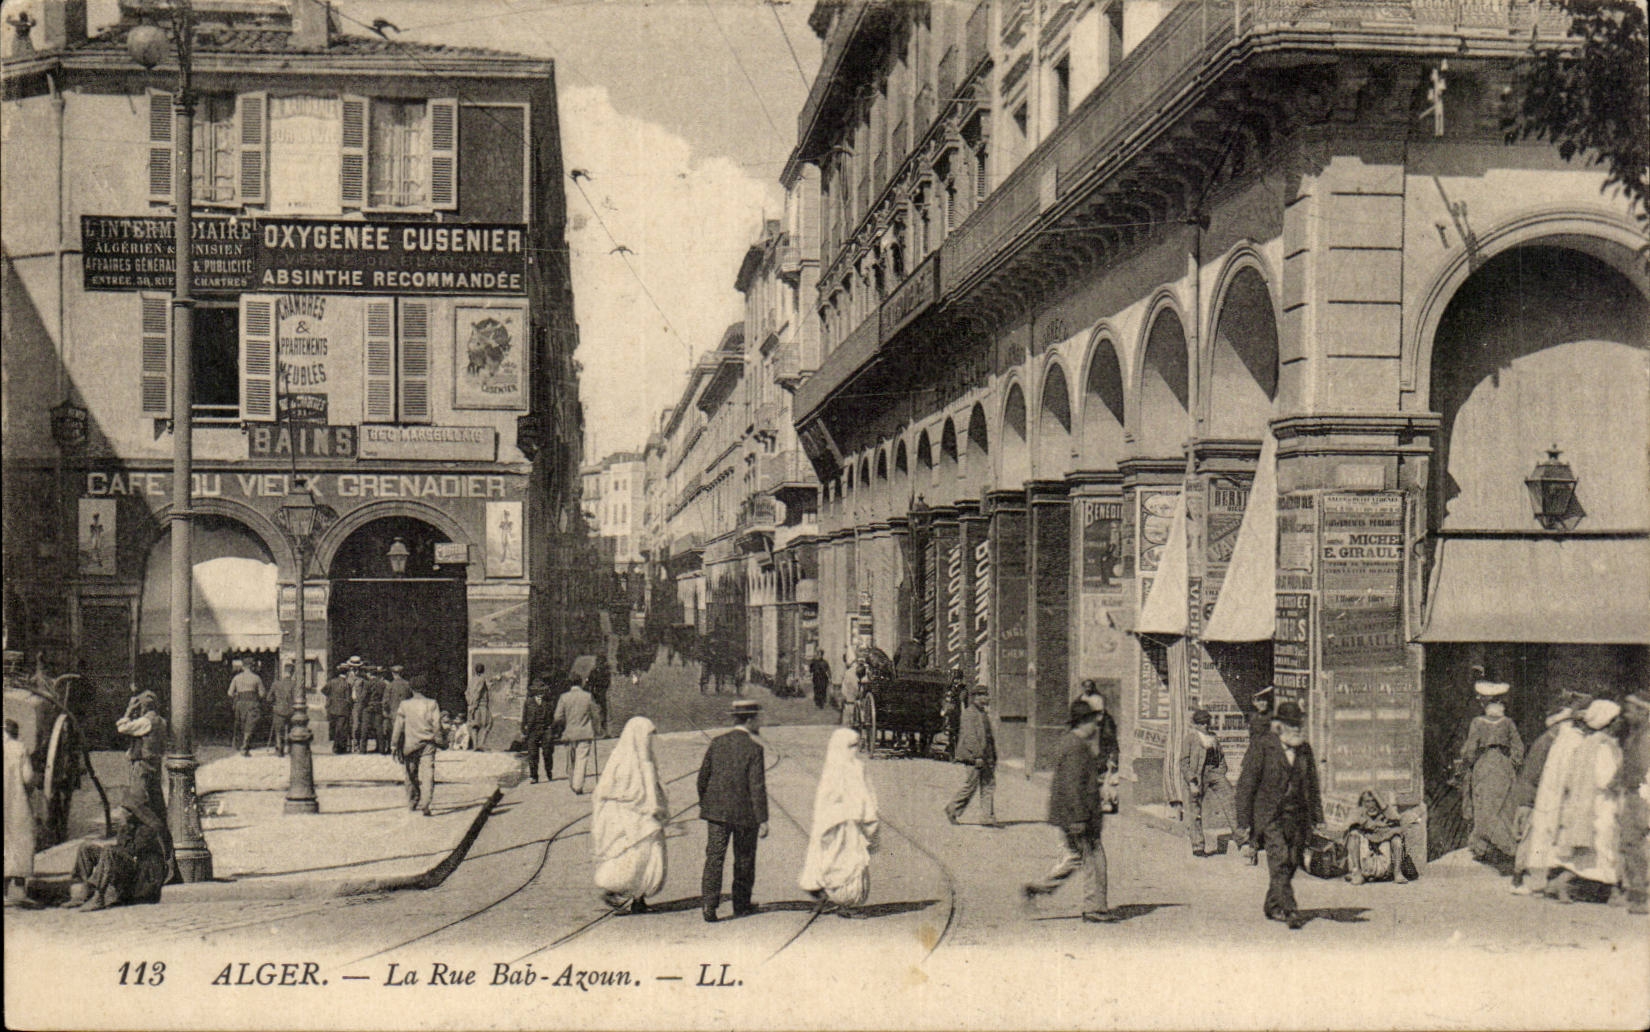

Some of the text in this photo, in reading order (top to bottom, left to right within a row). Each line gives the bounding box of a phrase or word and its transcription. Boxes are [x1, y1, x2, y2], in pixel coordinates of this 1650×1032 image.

[264, 224, 521, 252] OXYGÉNÉE CUSENIER
[95, 241, 162, 254] ALGÉRIEN
[85, 256, 131, 272] AFFAIRES
[135, 257, 177, 272] GÉNÉRAL
[193, 260, 200, 273] &
[154, 277, 175, 287] RUE
[262, 269, 521, 289] ABSINTHE RECOMMANDÉE
[277, 293, 326, 320] CHAMBRES
[295, 320, 310, 334] &
[253, 427, 351, 456] BAINS
[337, 475, 506, 497] GRENADIER
[1324, 547, 1405, 558] E. GIRAULT
